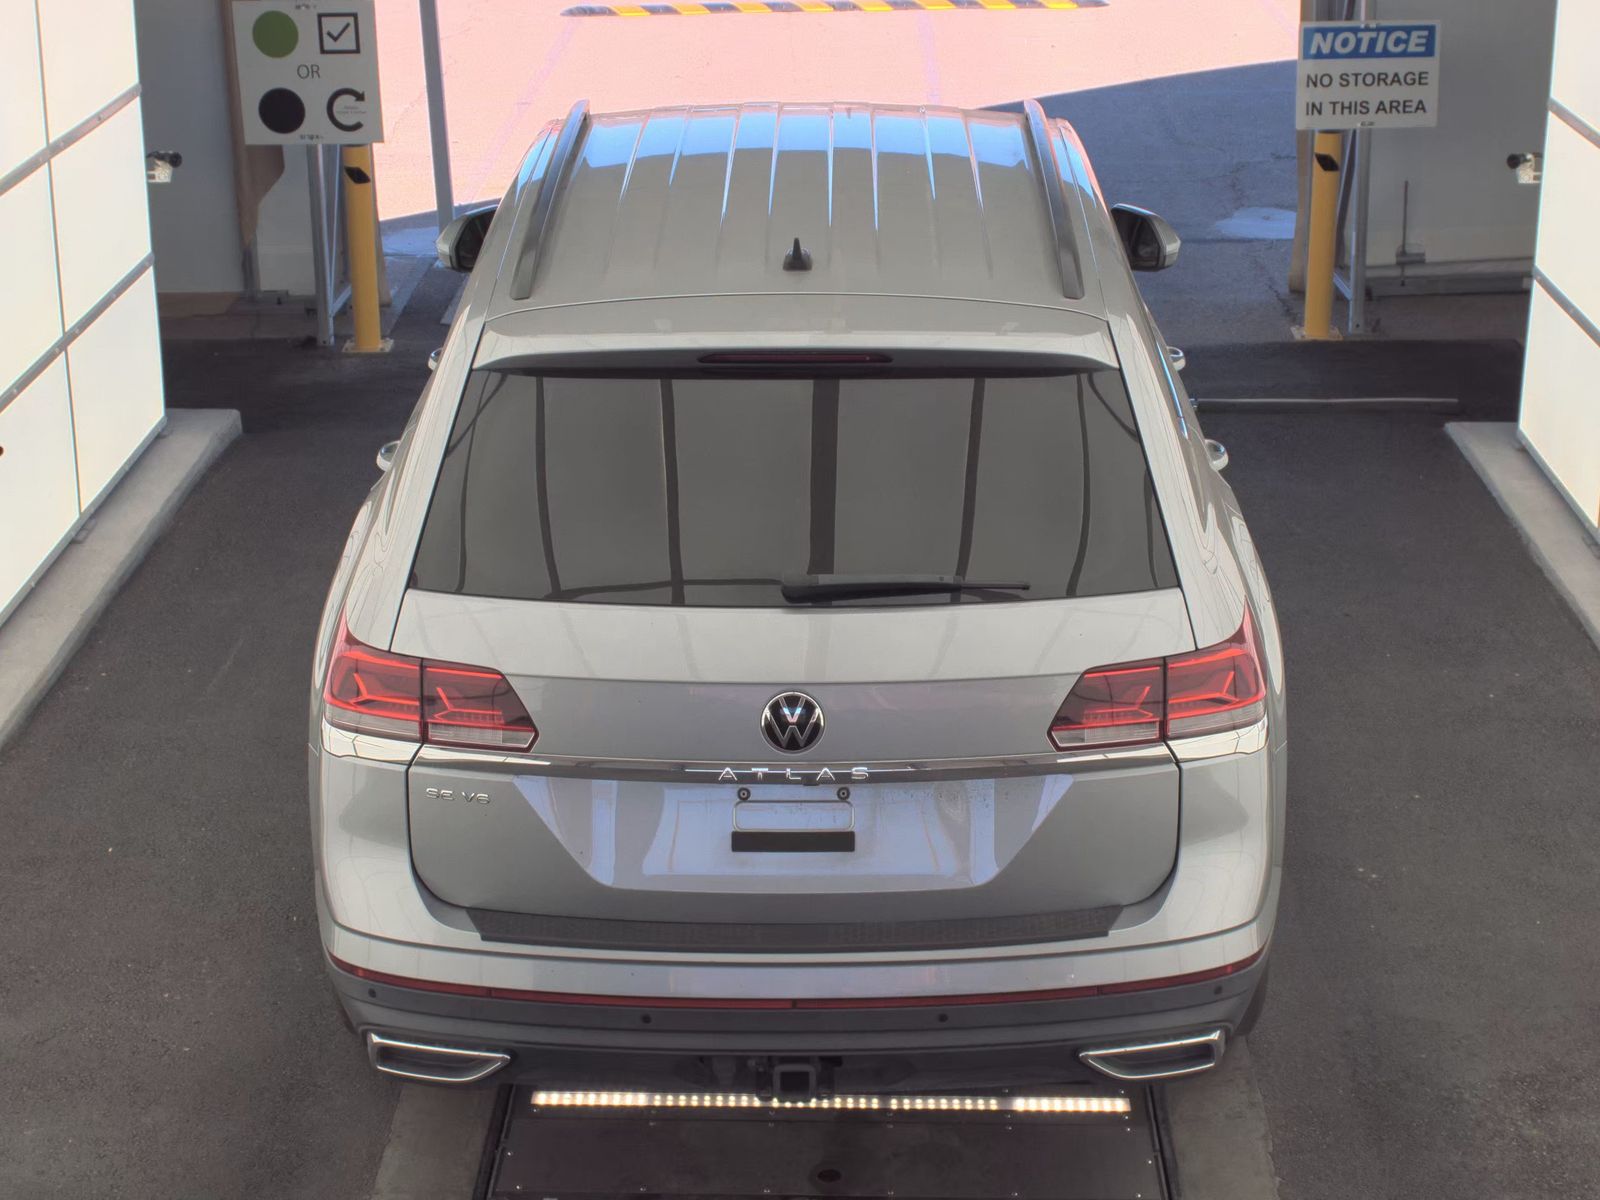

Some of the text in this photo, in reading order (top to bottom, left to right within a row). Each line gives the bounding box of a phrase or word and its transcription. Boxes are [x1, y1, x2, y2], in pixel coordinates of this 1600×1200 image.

[1310, 30, 1429, 54] NOTICE
[296, 64, 321, 79] OR
[1306, 71, 1429, 88] NO STORAGE
[1305, 99, 1427, 116] IN THIS AREA
[763, 693, 823, 752] VW
[718, 767, 869, 781] ATLAS
[461, 791, 490, 804] V6
